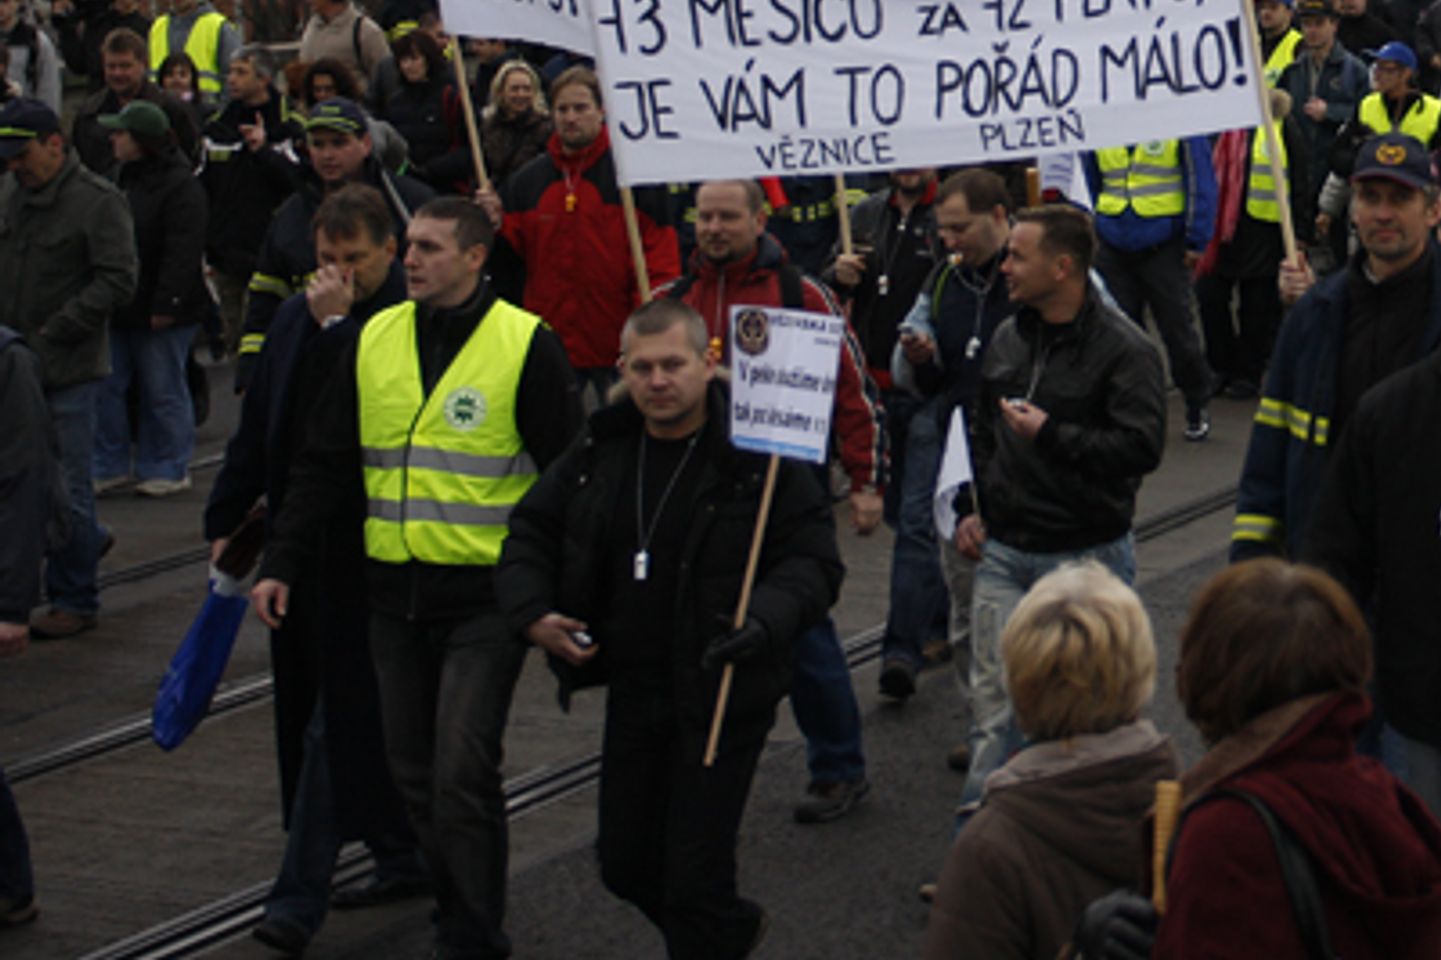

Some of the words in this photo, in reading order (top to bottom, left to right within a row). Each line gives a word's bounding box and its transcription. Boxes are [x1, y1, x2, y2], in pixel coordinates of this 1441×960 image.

[917, 2, 969, 36] ZA
[614, 79, 680, 141] JE
[699, 57, 806, 133] VÁM
[834, 63, 906, 127] TO
[935, 34, 1080, 120] POŘÁD
[1100, 16, 1248, 104] MÁLO!
[755, 131, 896, 170] VĚZNICE
